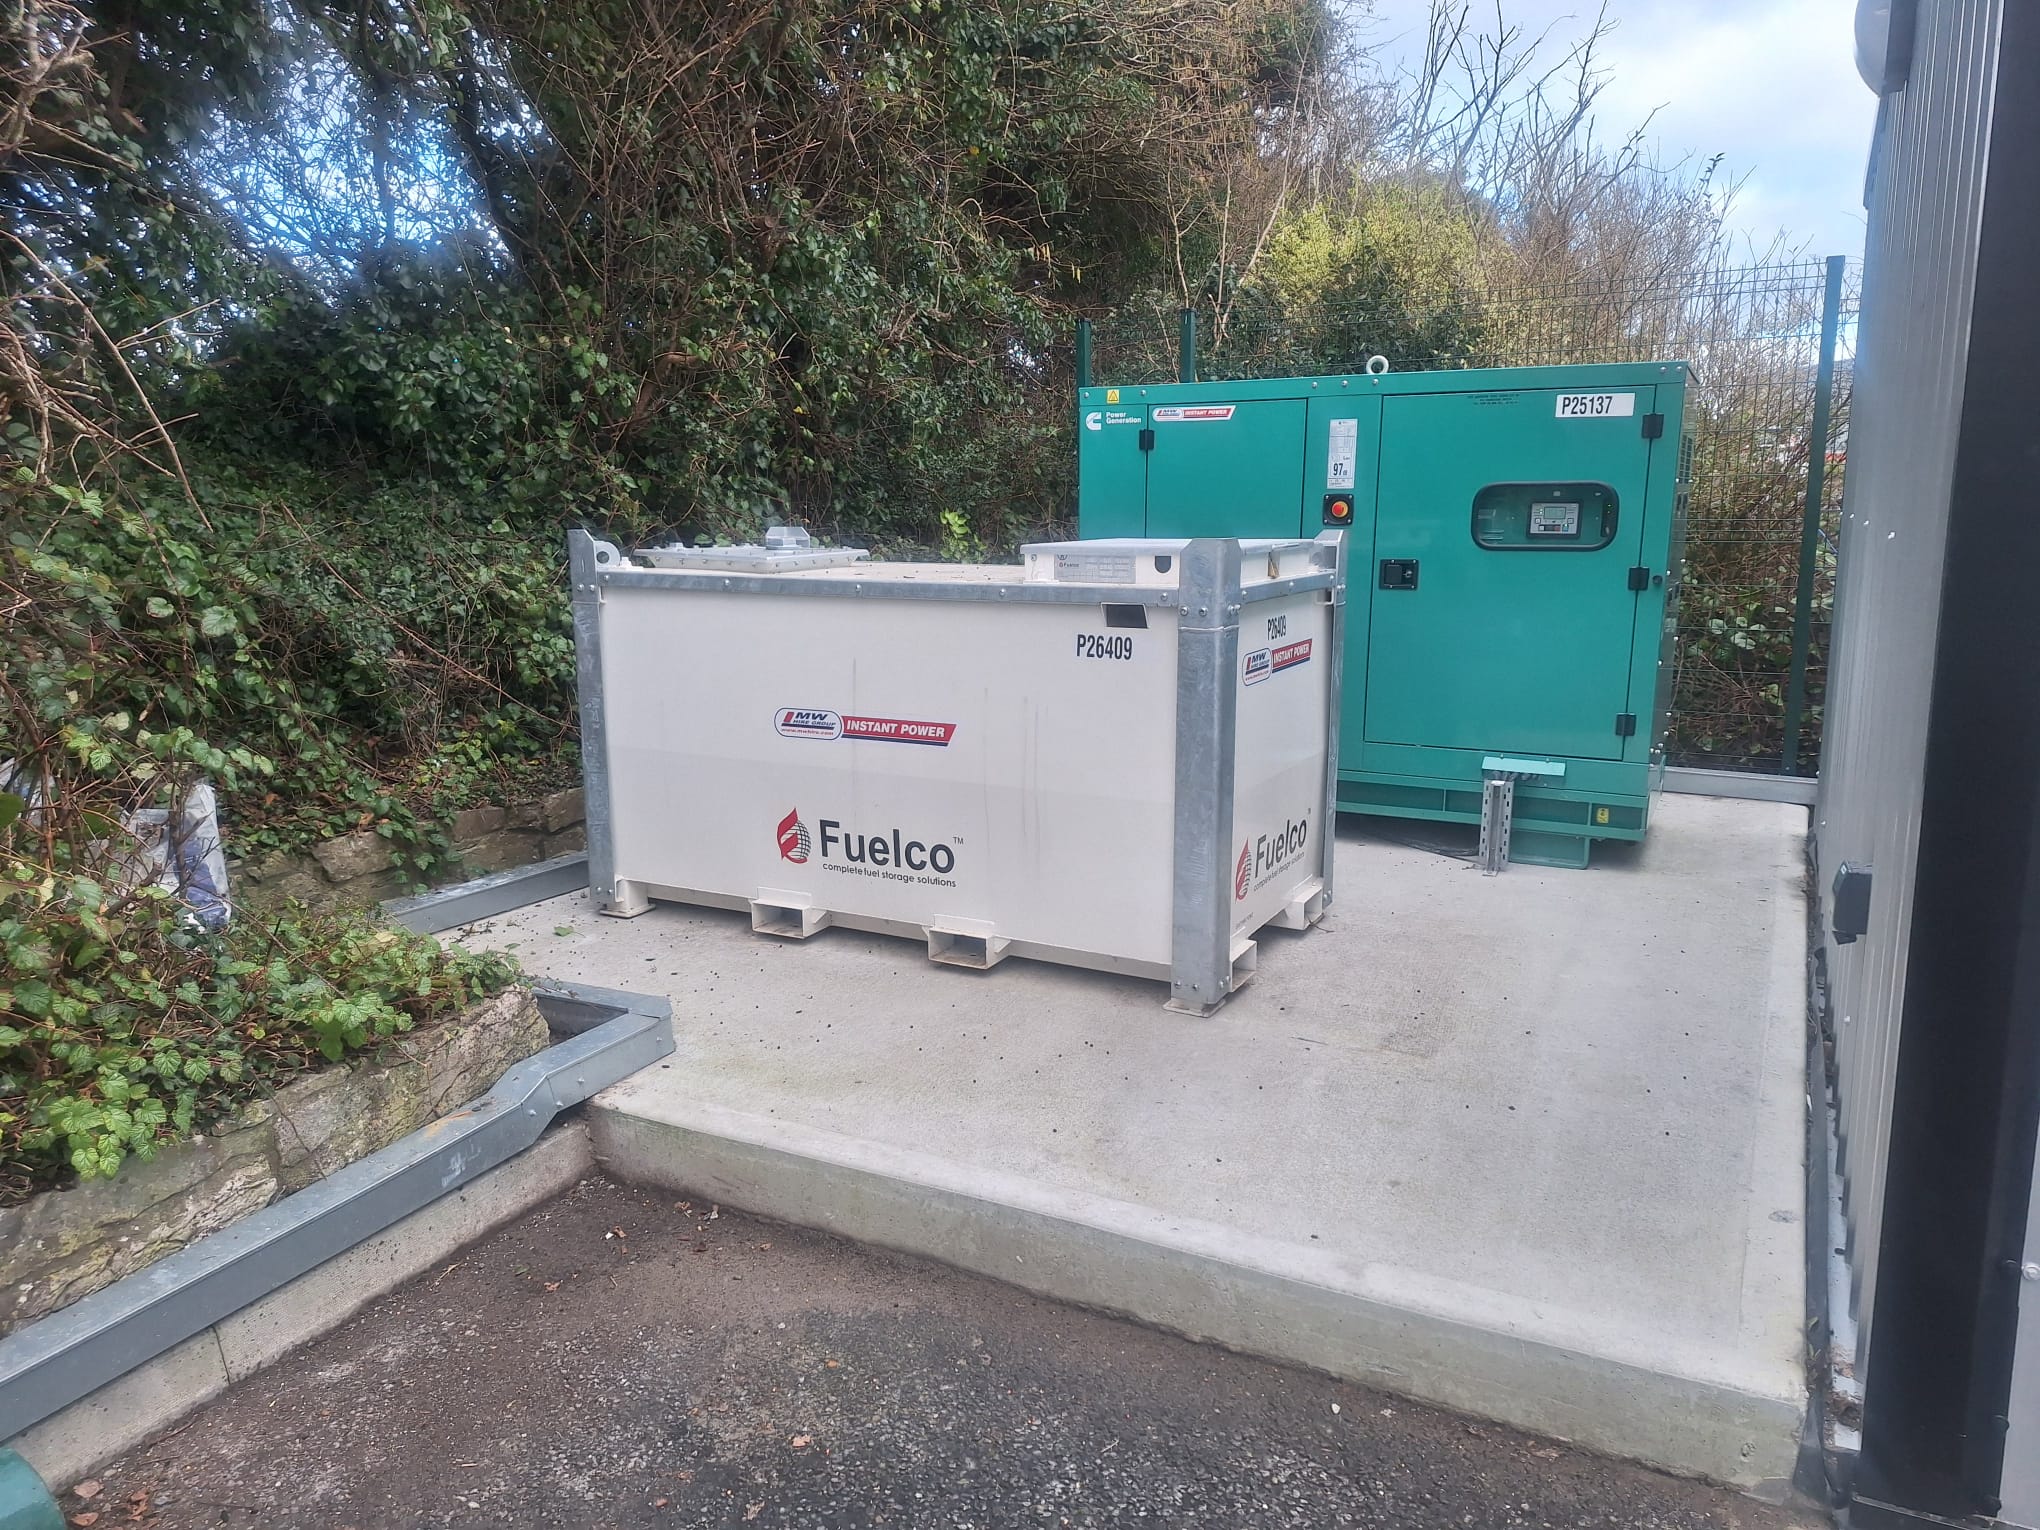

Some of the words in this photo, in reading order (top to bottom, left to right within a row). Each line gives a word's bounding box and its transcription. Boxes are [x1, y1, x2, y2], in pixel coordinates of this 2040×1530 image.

[1562, 396, 1613, 415] P25137
[1106, 417, 1142, 425] Generation
[1333, 463, 1343, 476] 97
[1266, 615, 1287, 641] P26409
[1076, 634, 1133, 660] P26409
[1273, 647, 1294, 664] INSTANT
[1294, 643, 1310, 657] POWER
[1252, 652, 1267, 663] MW
[795, 711, 828, 721] MW
[846, 719, 897, 734] INSTANT
[900, 724, 945, 738] POWER
[819, 819, 955, 874] Fuelco
[1254, 819, 1307, 879] Fuelco
[822, 862, 863, 876] complete
[863, 868, 880, 878] fuel
[881, 871, 915, 884] storage
[917, 875, 957, 888] solutions
